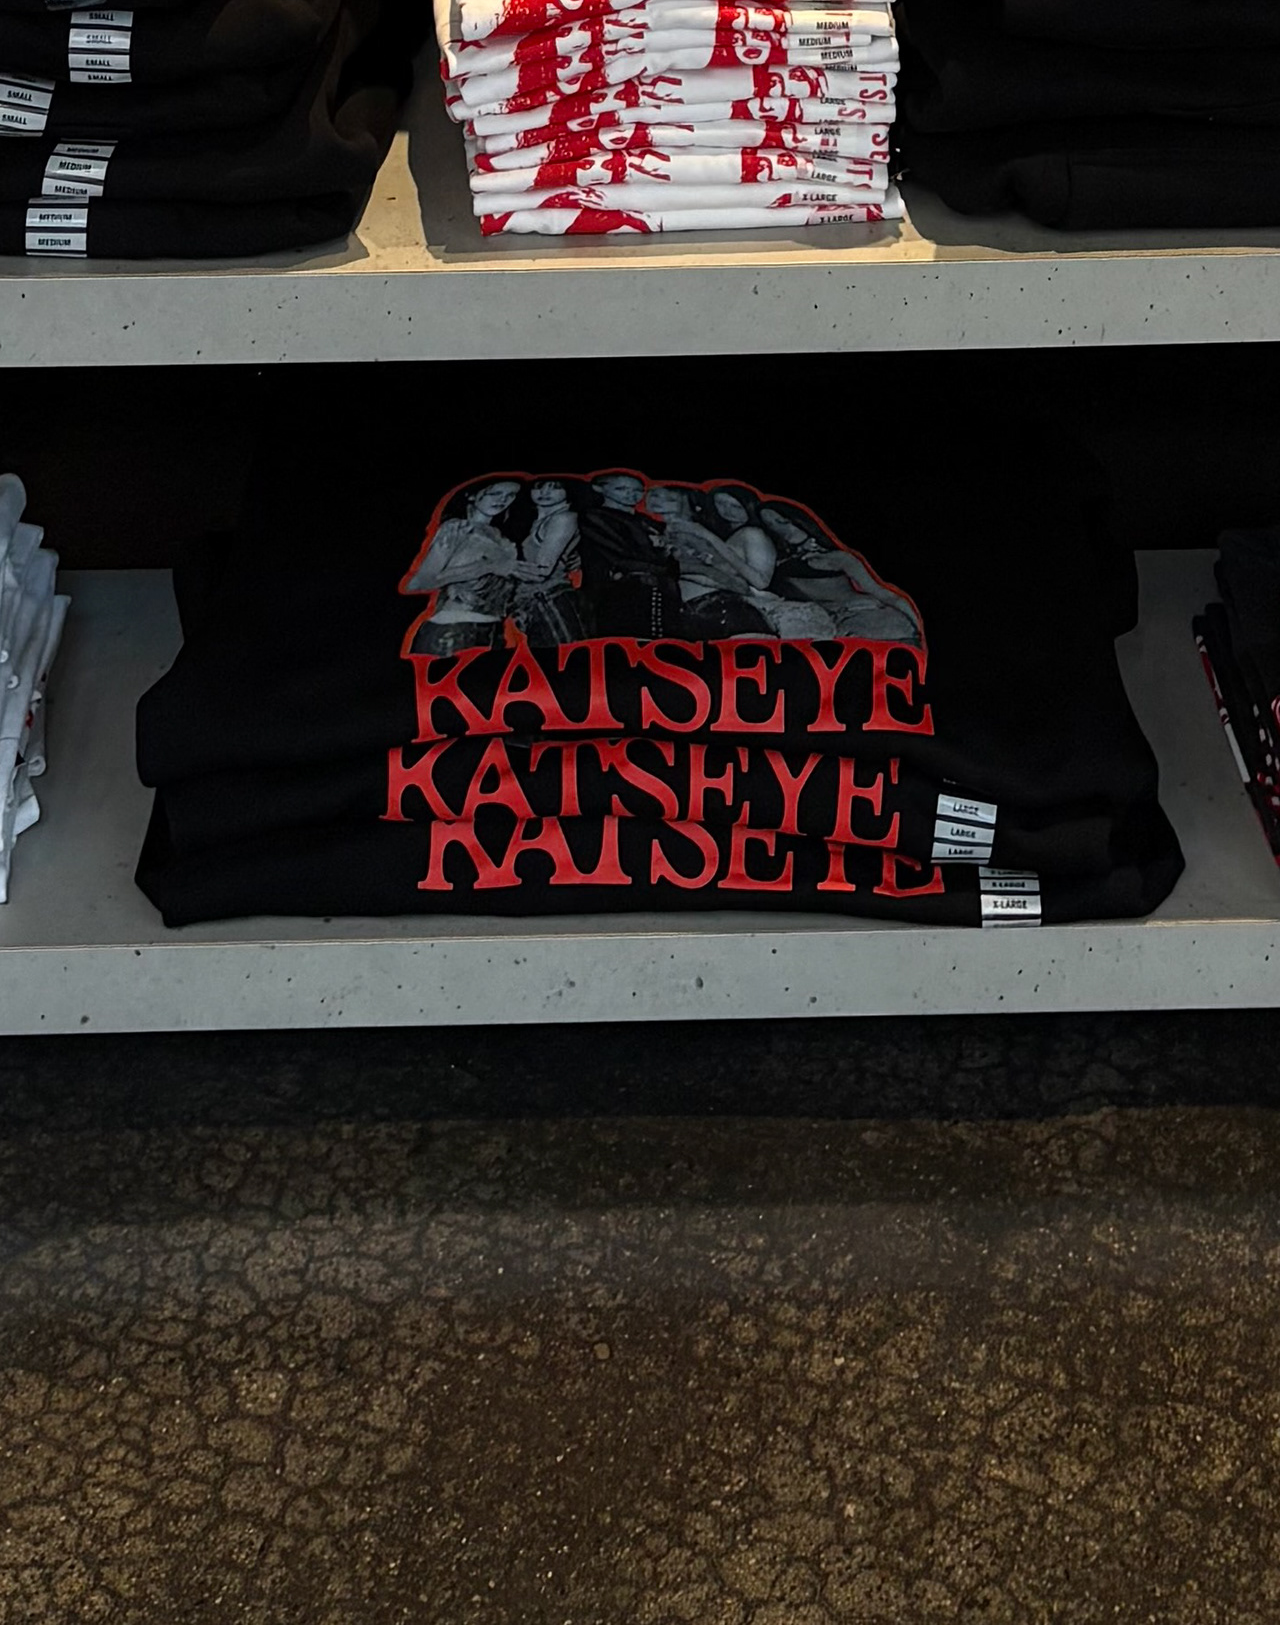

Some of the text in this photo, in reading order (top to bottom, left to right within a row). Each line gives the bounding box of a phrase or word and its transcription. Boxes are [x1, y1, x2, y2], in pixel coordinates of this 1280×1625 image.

[89, 13, 114, 21] SMALL
[816, 21, 849, 30] MEDIUM
[799, 37, 831, 46] MEDIUM
[821, 50, 853, 60] MEDIUM
[8, 90, 32, 101] SMALL
[2, 114, 27, 125] SMALL
[59, 161, 92, 171] MEDIUM
[811, 173, 837, 182] LARGE
[55, 185, 88, 194] MEDIUM
[38, 238, 71, 246] MEDIUM
[411, 637, 936, 744] KATSEYE
[378, 738, 903, 850] KATSEYE
[951, 828, 976, 839] LARGE
